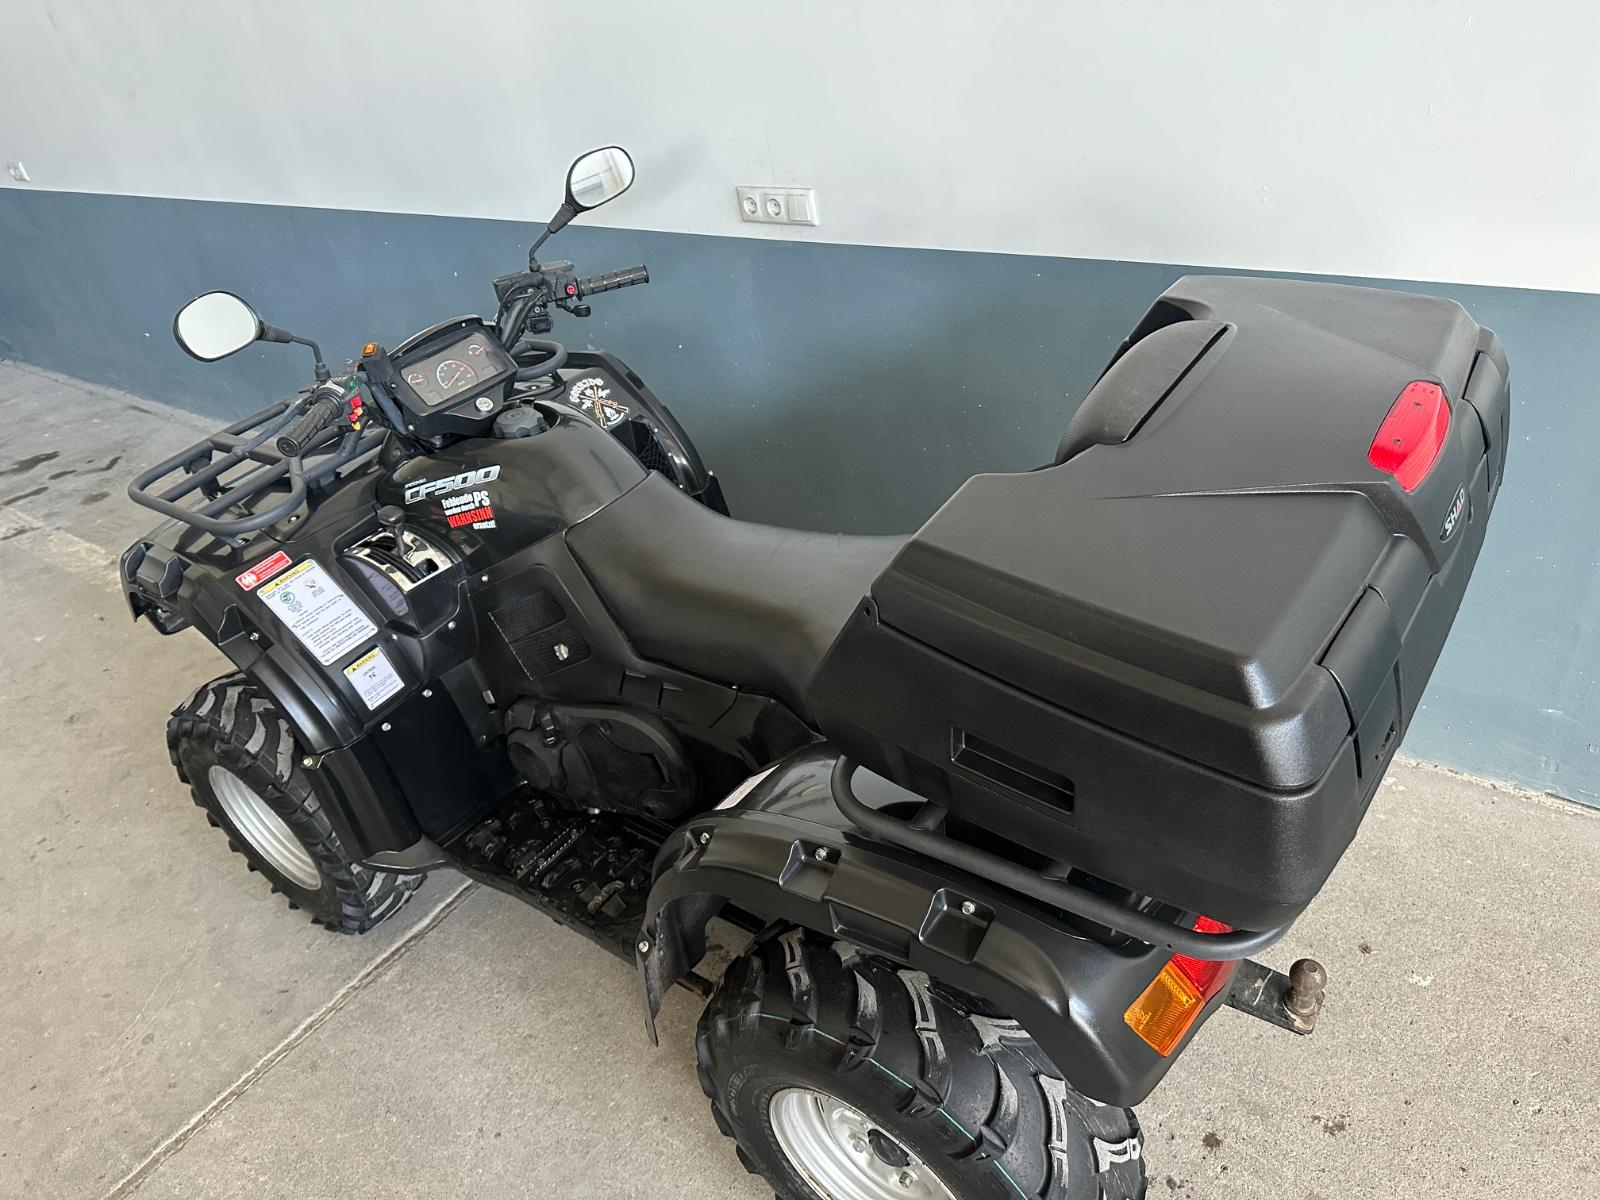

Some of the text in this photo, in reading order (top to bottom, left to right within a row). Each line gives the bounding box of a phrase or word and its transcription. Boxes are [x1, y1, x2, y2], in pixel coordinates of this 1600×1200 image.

[404, 465, 500, 504] CF500
[441, 490, 491, 509] Fehlende PS
[447, 506, 494, 528] WAHNSINN
[1444, 487, 1465, 537] SHAD
